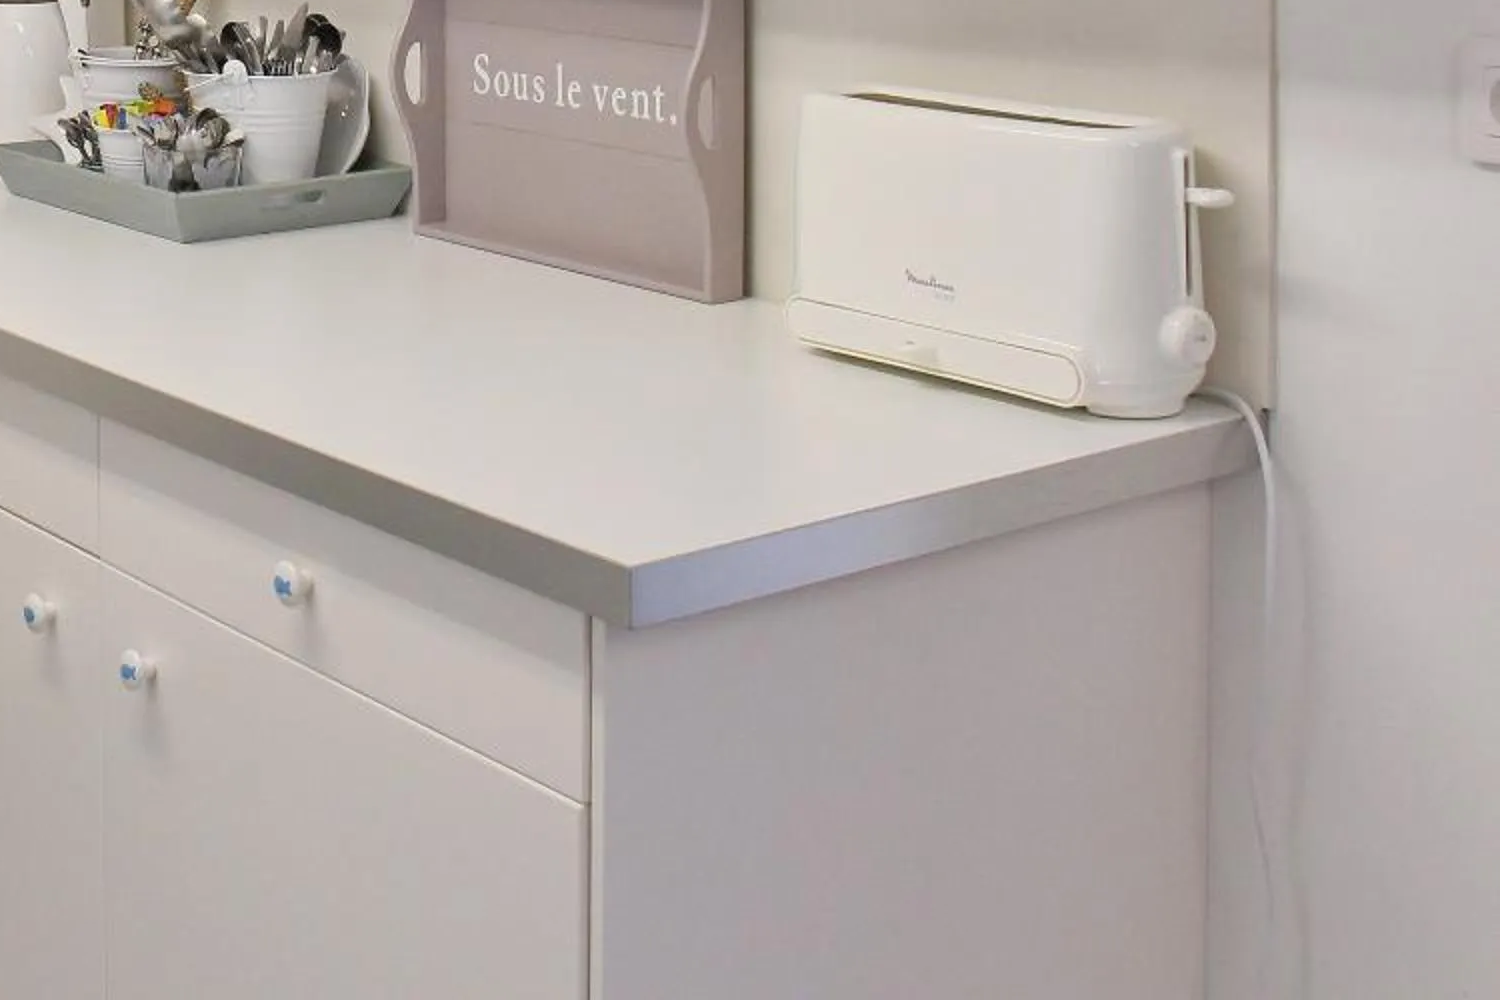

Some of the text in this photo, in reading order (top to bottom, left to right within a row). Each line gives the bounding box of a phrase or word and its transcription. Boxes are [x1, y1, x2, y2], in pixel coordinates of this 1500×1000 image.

[472, 53, 677, 126] Sous le vent.
